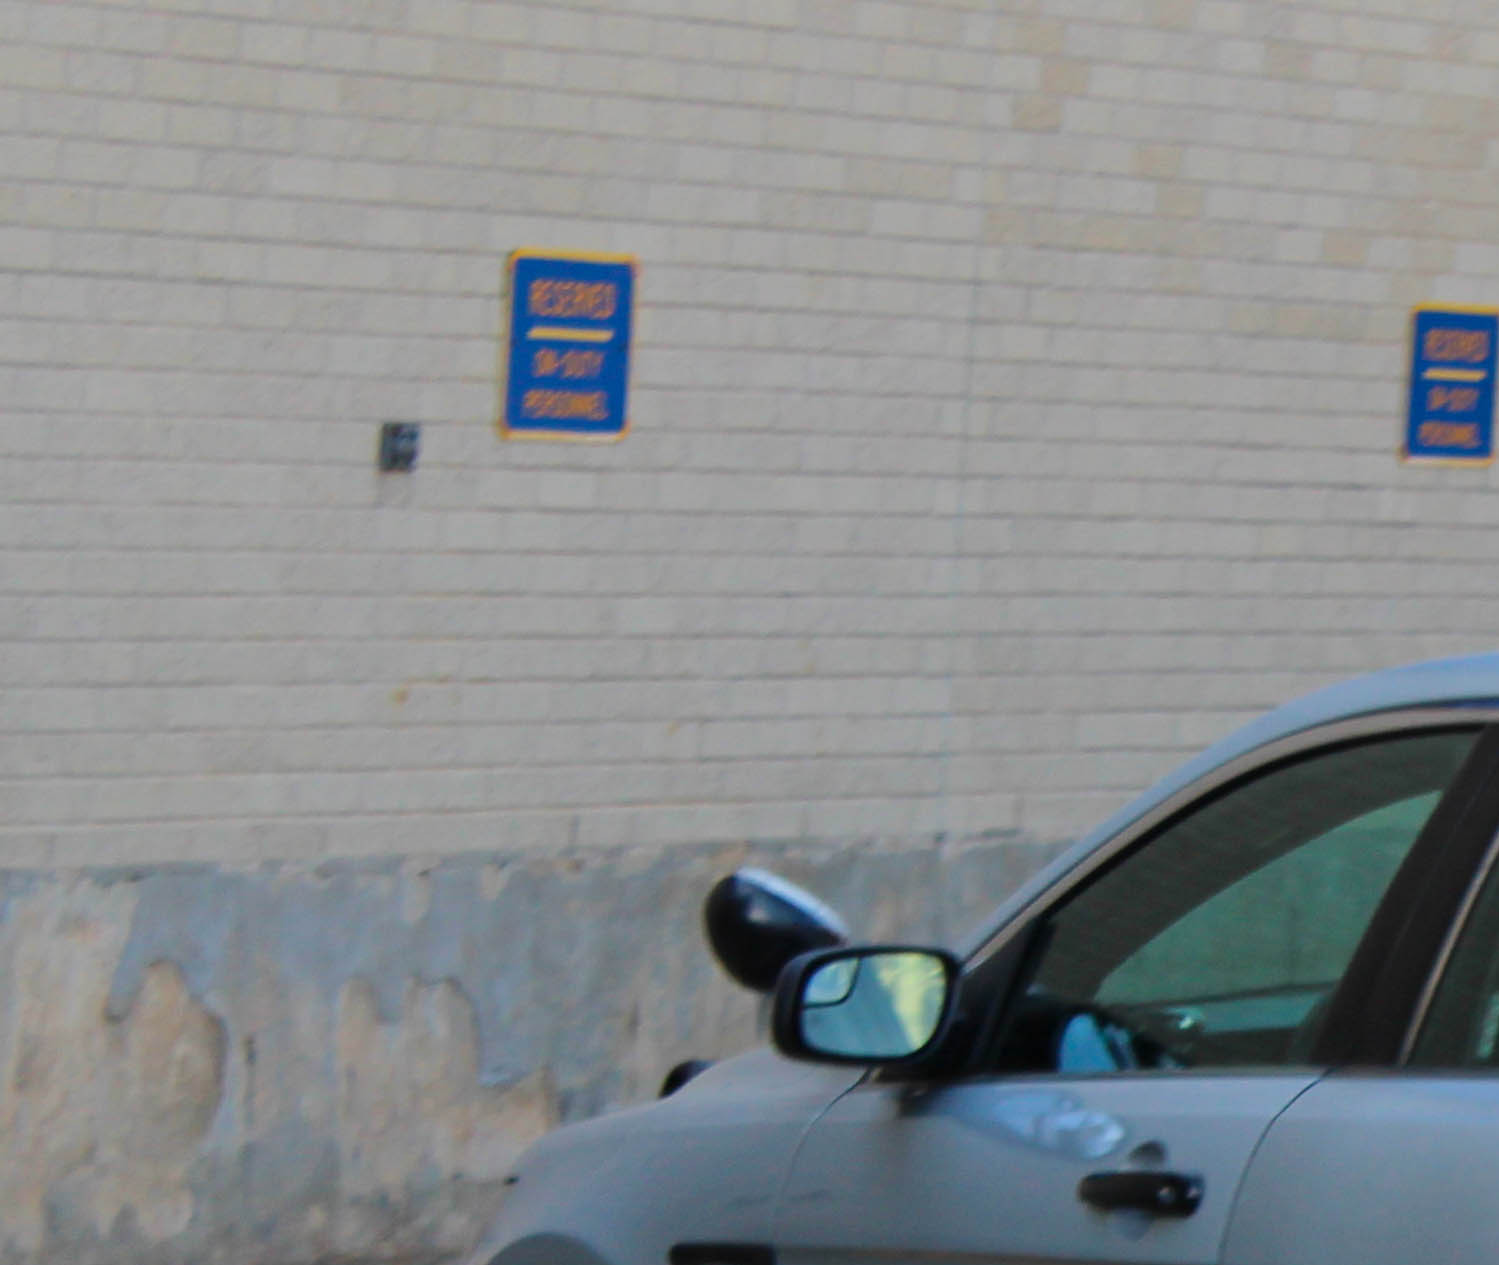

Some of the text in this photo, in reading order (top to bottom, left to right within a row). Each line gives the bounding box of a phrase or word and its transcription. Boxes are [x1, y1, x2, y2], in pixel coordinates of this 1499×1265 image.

[530, 279, 616, 320] RESERVED
[532, 348, 605, 378] ON-DUTY
[522, 388, 610, 420] PERSONNEL
